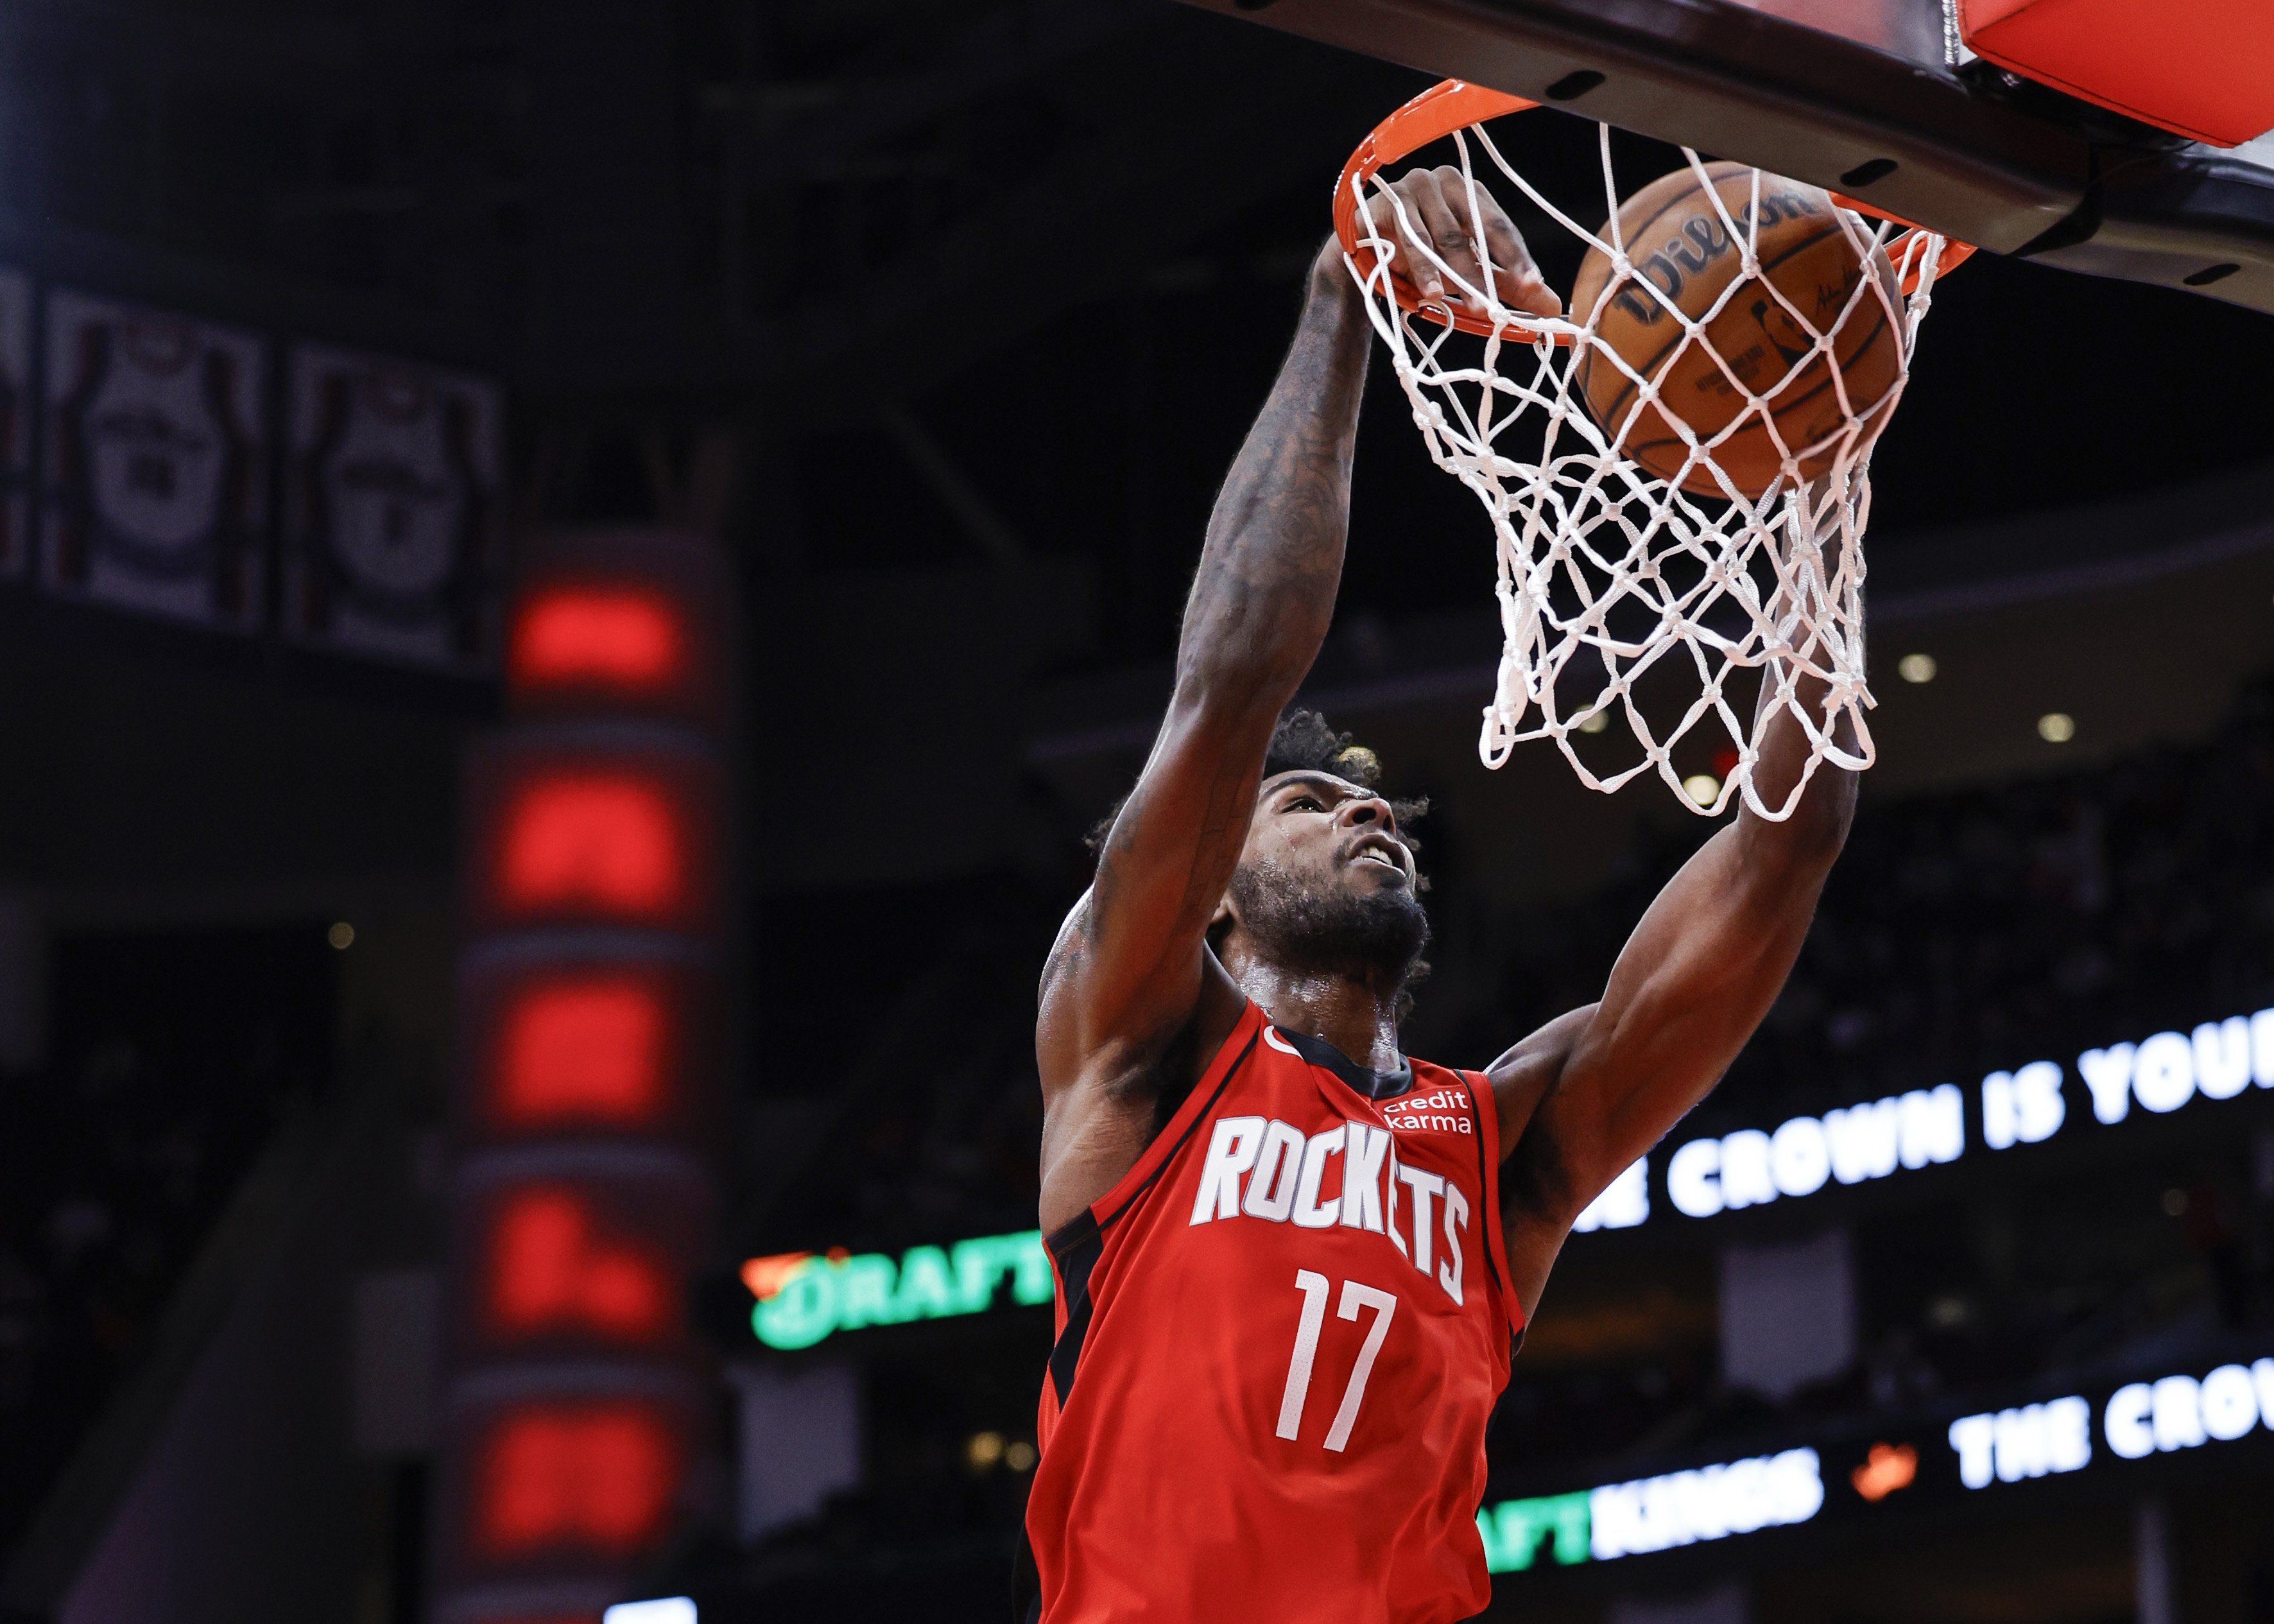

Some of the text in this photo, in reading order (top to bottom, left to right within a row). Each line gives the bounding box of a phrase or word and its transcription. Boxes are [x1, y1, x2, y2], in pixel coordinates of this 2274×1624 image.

[1383, 1091, 1469, 1113] credit
[1383, 1114, 1472, 1134] karma
[1667, 1084, 1965, 1218] CROWN
[1982, 1060, 2065, 1150] IS
[1189, 1116, 1470, 1307] ROCKETS
[1275, 1268, 1397, 1453] 17
[1949, 1395, 2092, 1489] THE
